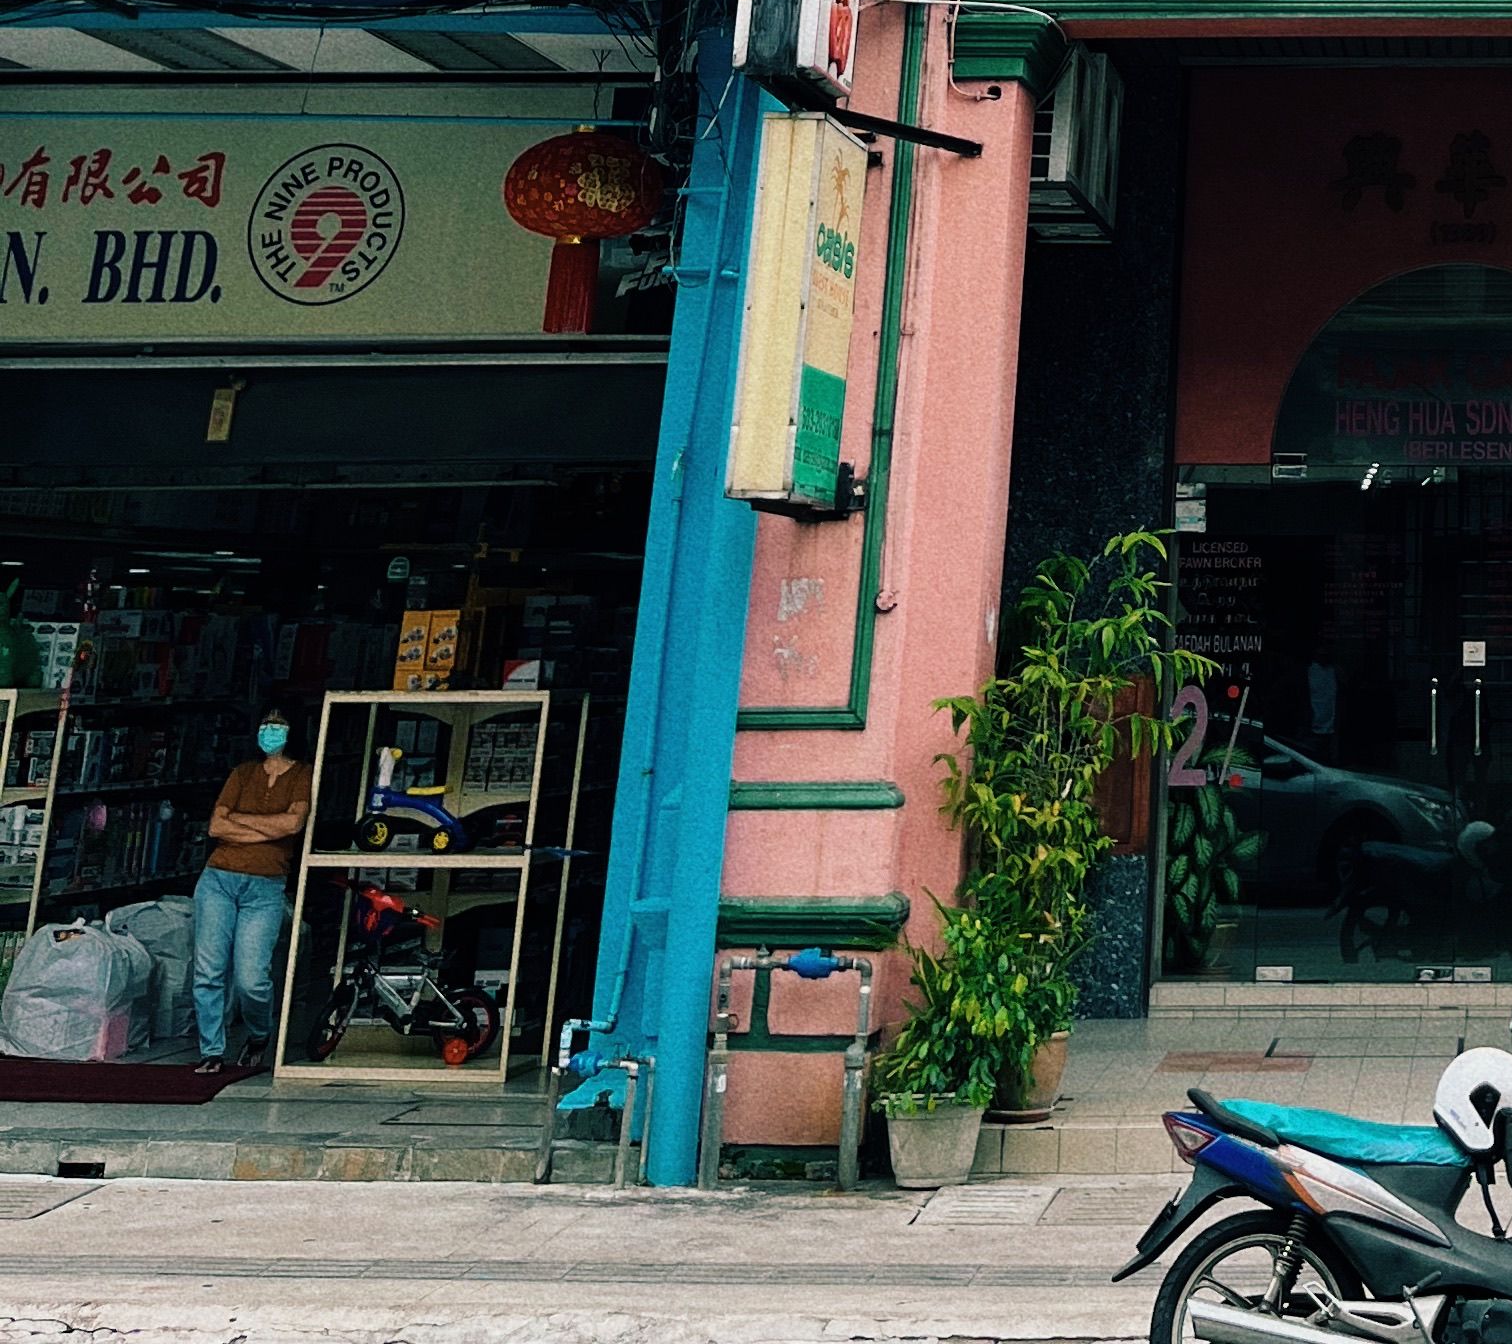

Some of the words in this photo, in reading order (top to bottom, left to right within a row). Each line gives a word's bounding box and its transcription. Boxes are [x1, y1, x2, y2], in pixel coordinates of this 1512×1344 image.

[0, 146, 226, 209] 有限公司
[264, 162, 320, 221] NINE
[327, 157, 393, 282] PRODUCTS
[82, 230, 222, 304] BHD.
[261, 229, 297, 283] THE
[1335, 400, 1400, 435] HENG
[1409, 400, 1456, 435] HUA
[1192, 541, 1249, 554] LICENSED
